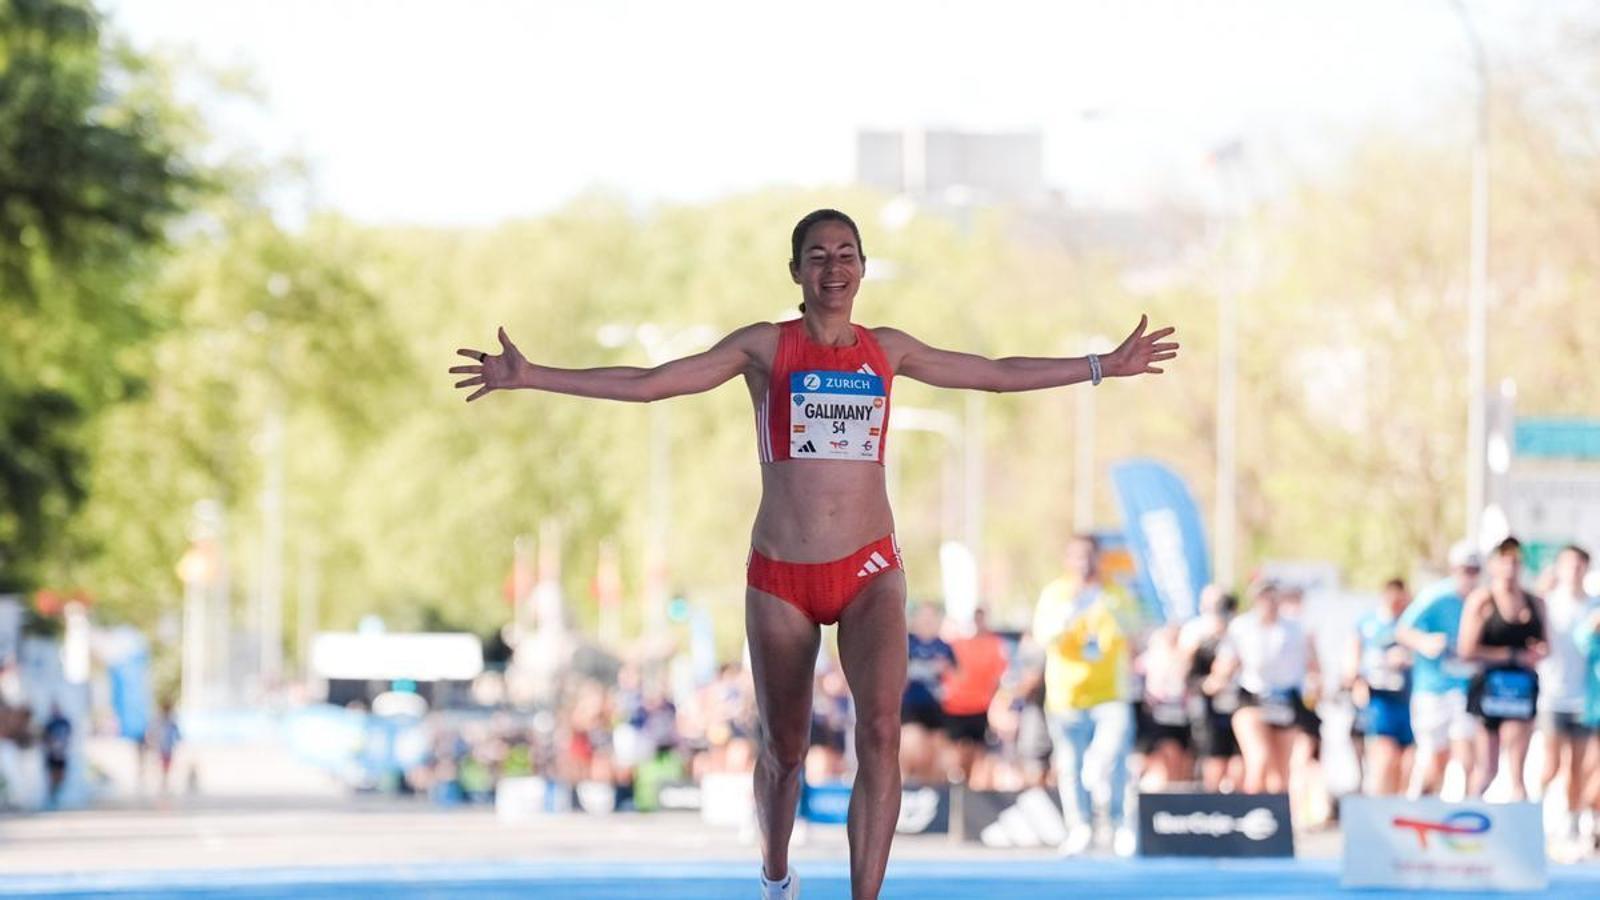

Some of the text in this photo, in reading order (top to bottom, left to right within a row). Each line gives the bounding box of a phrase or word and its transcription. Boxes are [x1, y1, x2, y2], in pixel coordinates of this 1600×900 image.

[826, 377, 870, 389] ZURICH
[805, 403, 873, 421] GALIMANY
[832, 421, 845, 434] 54
